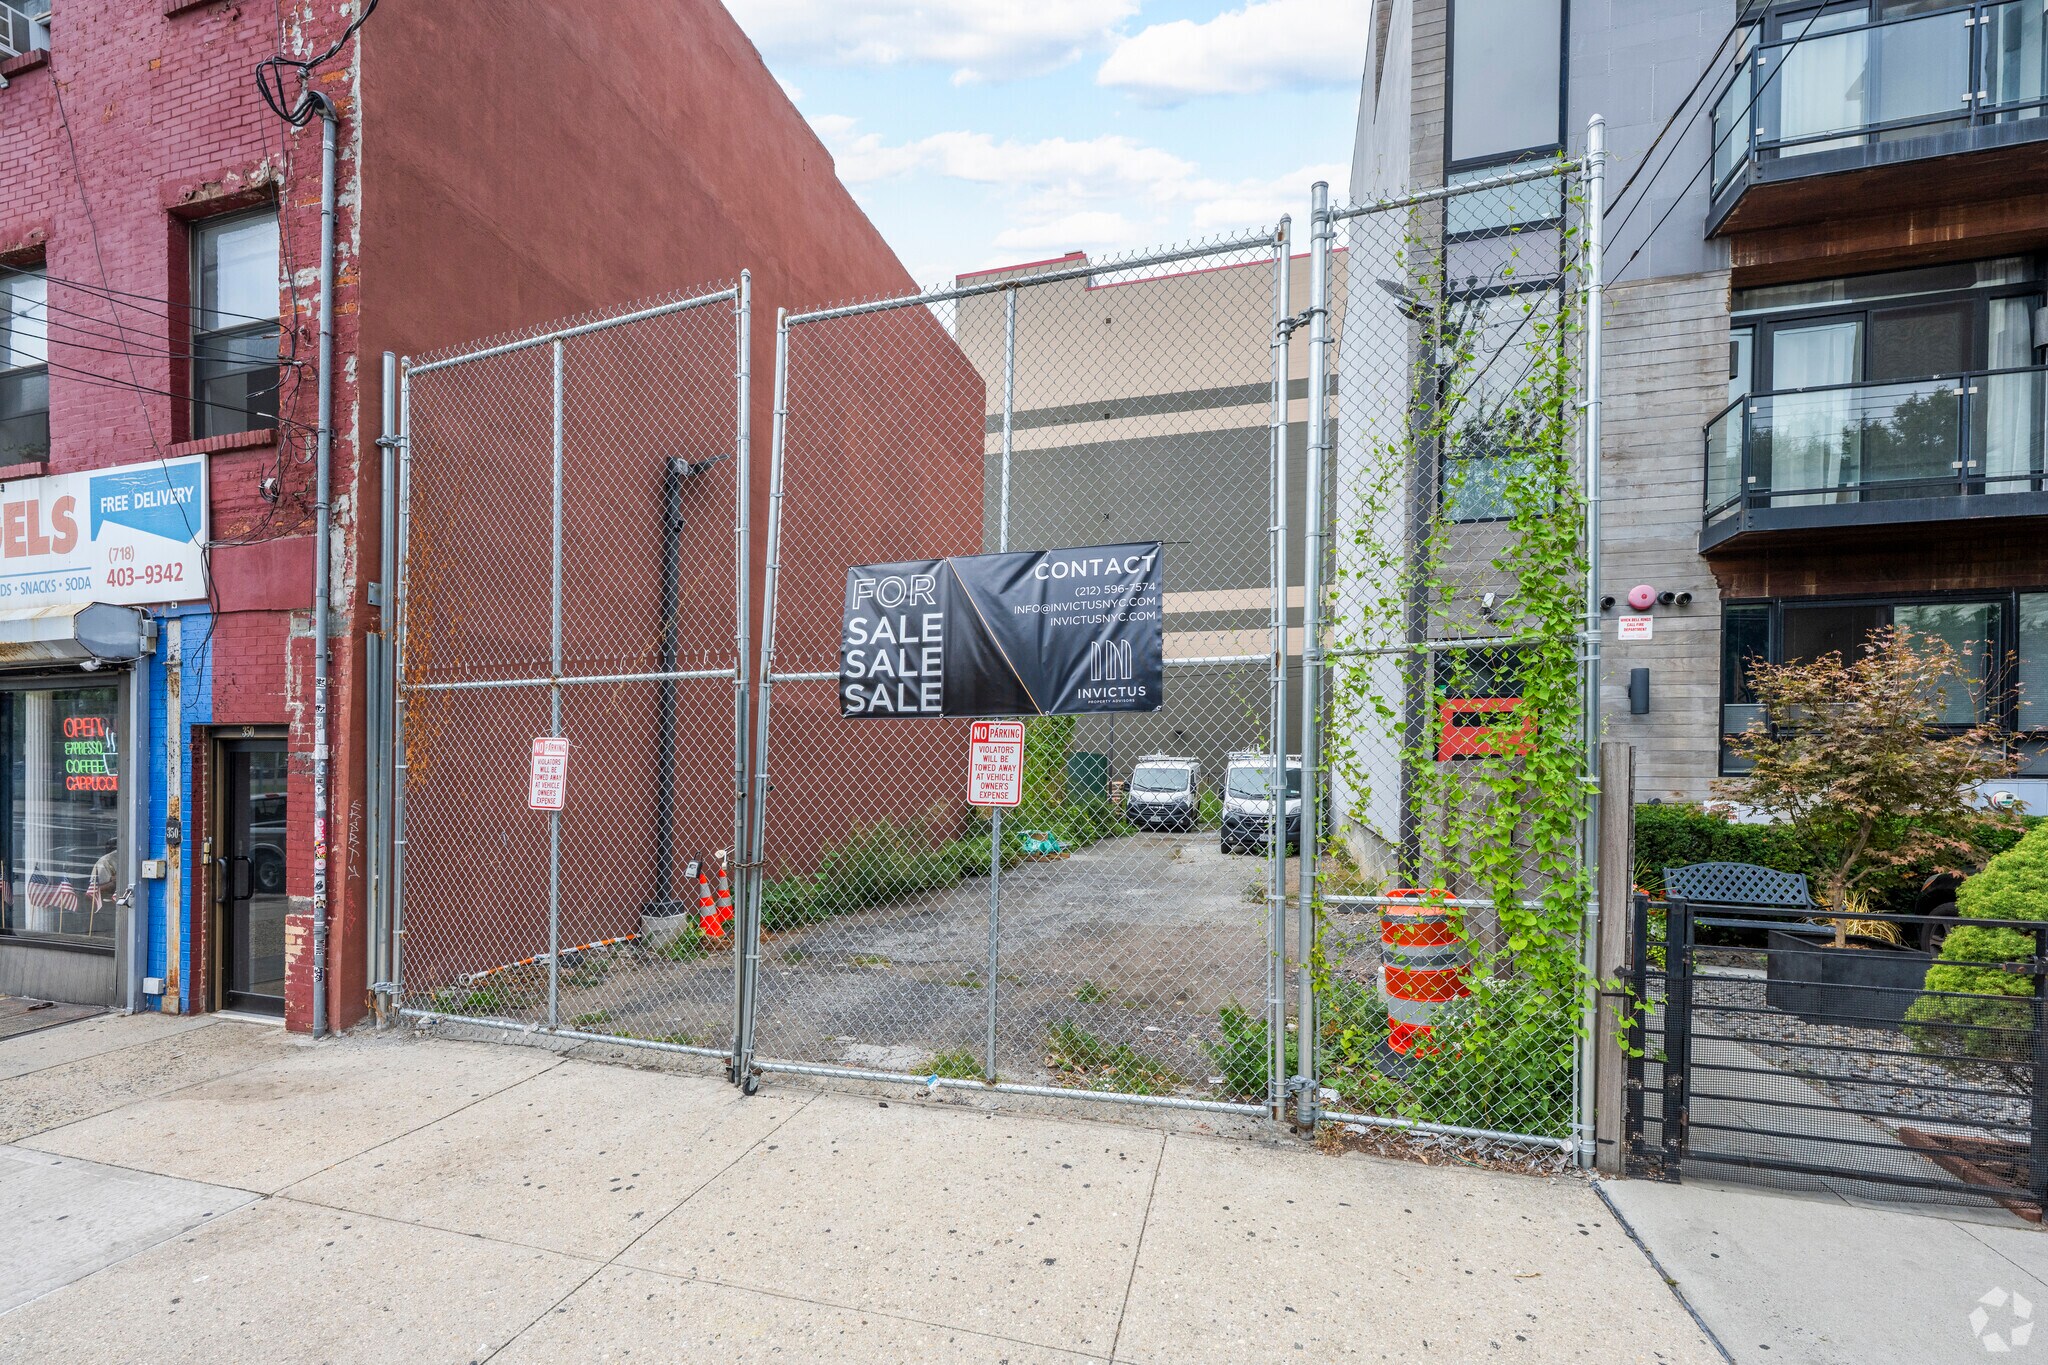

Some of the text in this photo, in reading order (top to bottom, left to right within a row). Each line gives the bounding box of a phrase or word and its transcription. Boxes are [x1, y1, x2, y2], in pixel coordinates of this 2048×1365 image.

[101, 486, 194, 513] FREE DELIVERY
[0, 495, 78, 558] ELS
[109, 545, 134, 564] (718)
[107, 562, 183, 587] 403-9342
[1034, 554, 1156, 580] CONTACT
[21, 580, 56, 595] SNACKS
[65, 576, 92, 591] SODA
[852, 574, 936, 609] FOR
[1075, 582, 1156, 597] (212) 596-7574
[1014, 597, 1156, 614] INFO@INVICTUSNYC.COM
[1050, 612, 1156, 626] INVICTUSNYC.COM
[847, 613, 943, 645] SALE
[845, 647, 942, 678] SALE
[845, 682, 942, 712] SALE
[1078, 686, 1146, 698] INVICTUS
[242, 726, 255, 737] 350
[973, 726, 1020, 739] NO PARKING
[535, 742, 565, 753] NO PARKING
[66, 759, 106, 773] COFFEE
[167, 827, 179, 838] 350
